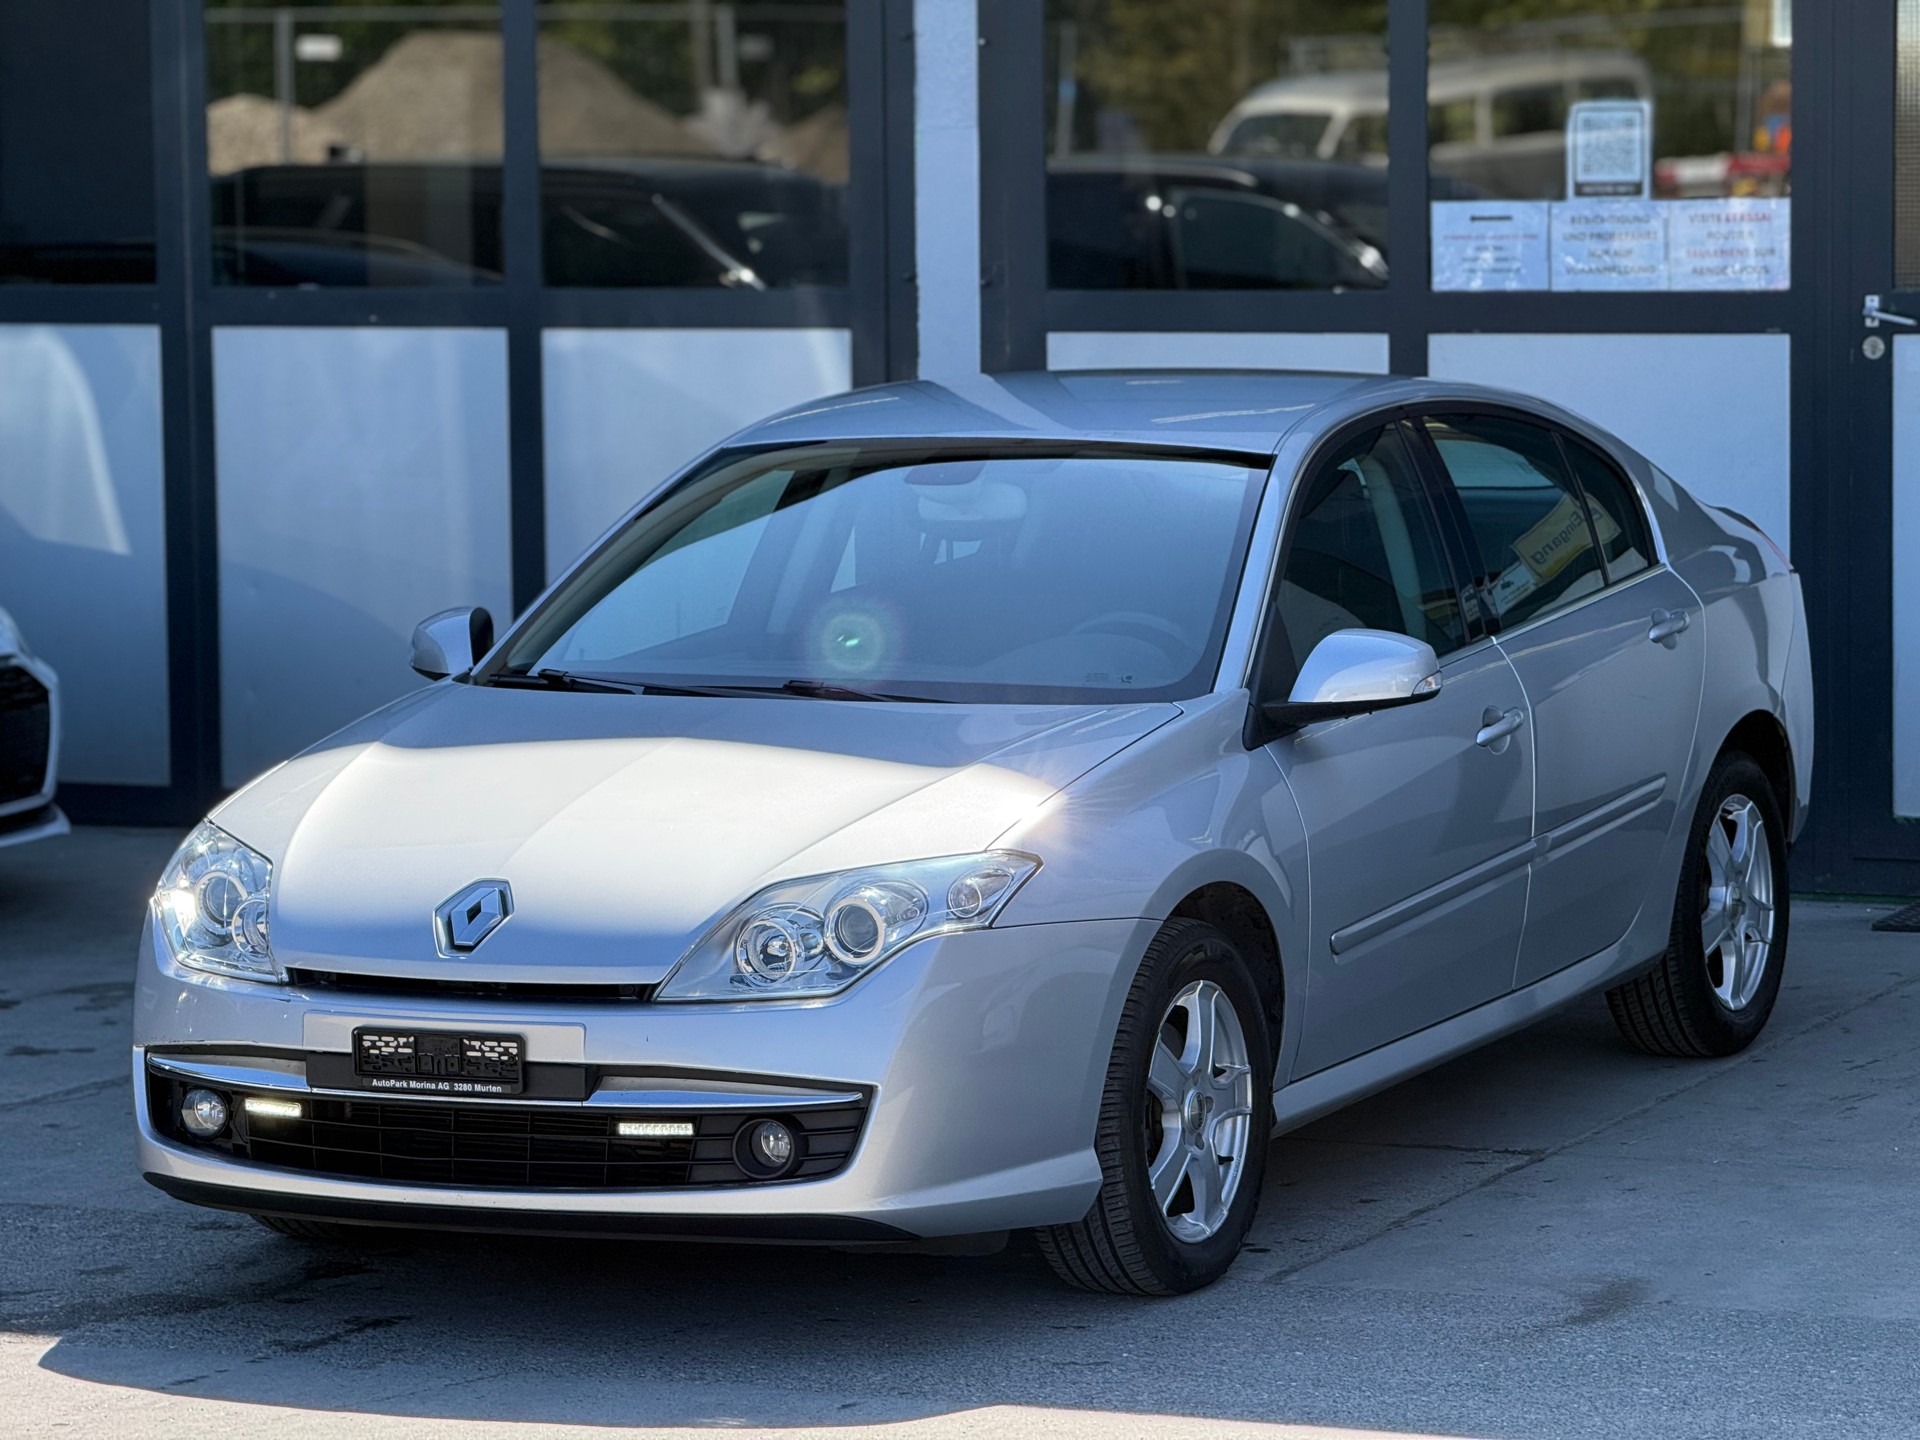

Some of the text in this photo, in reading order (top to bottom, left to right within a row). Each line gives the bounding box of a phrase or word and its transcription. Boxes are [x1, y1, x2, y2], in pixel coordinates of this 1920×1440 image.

[372, 1078, 502, 1093] AutoPark Morina AG 3280 Murten
